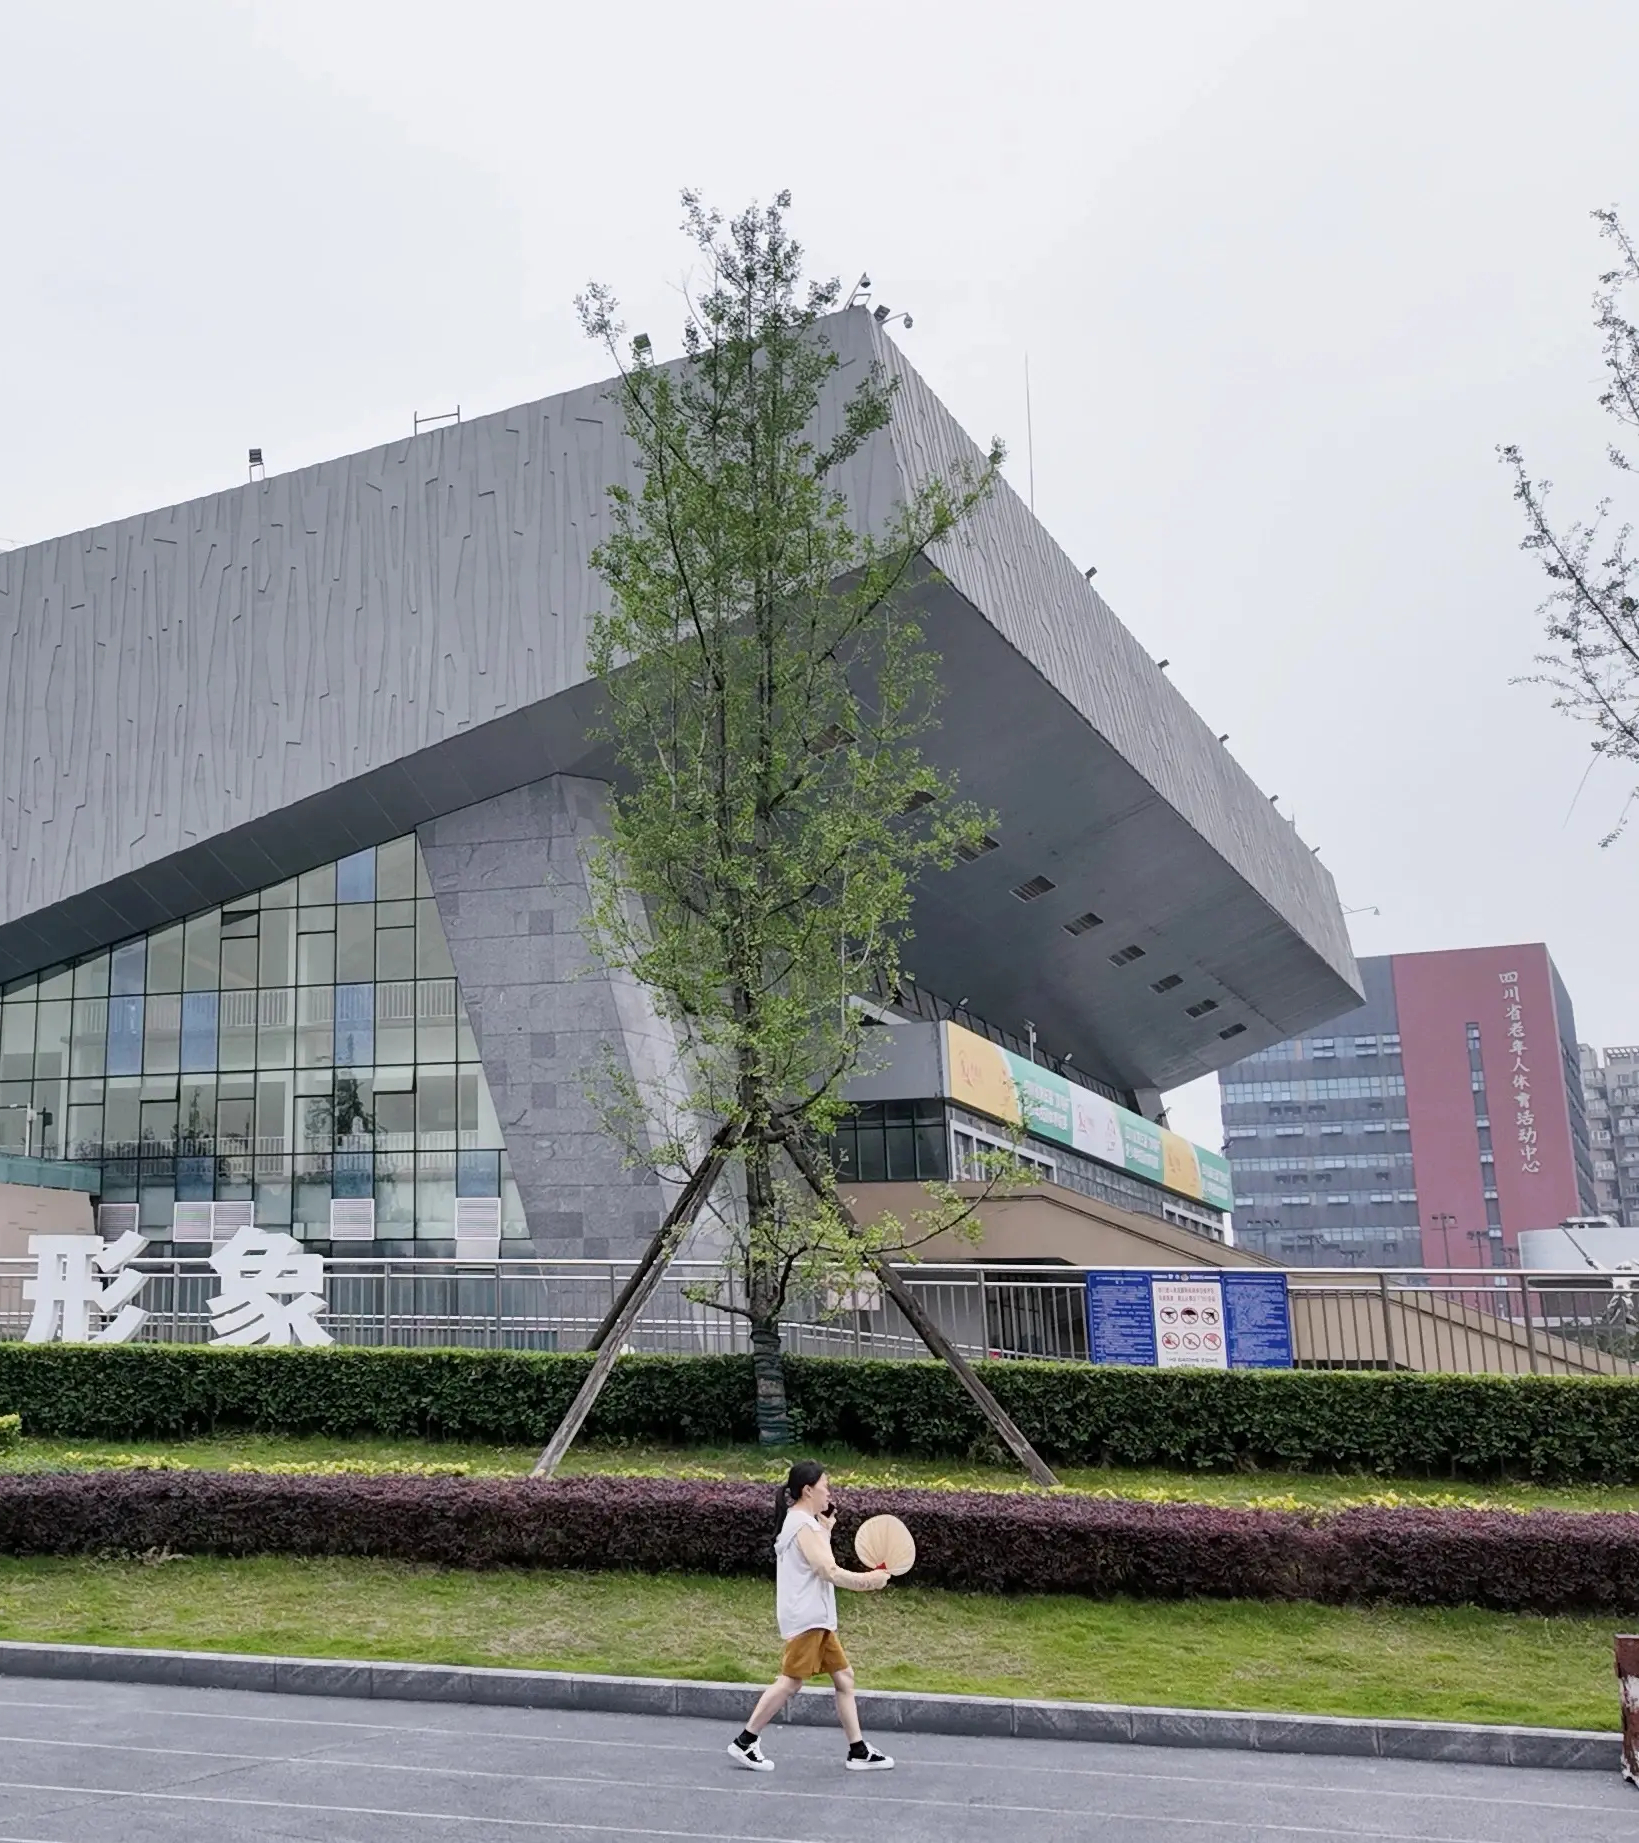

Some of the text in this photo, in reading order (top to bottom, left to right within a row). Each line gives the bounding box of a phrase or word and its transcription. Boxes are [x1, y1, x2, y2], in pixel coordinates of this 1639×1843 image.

[1499, 971, 1541, 1174] 四川省老年人体育活动中心
